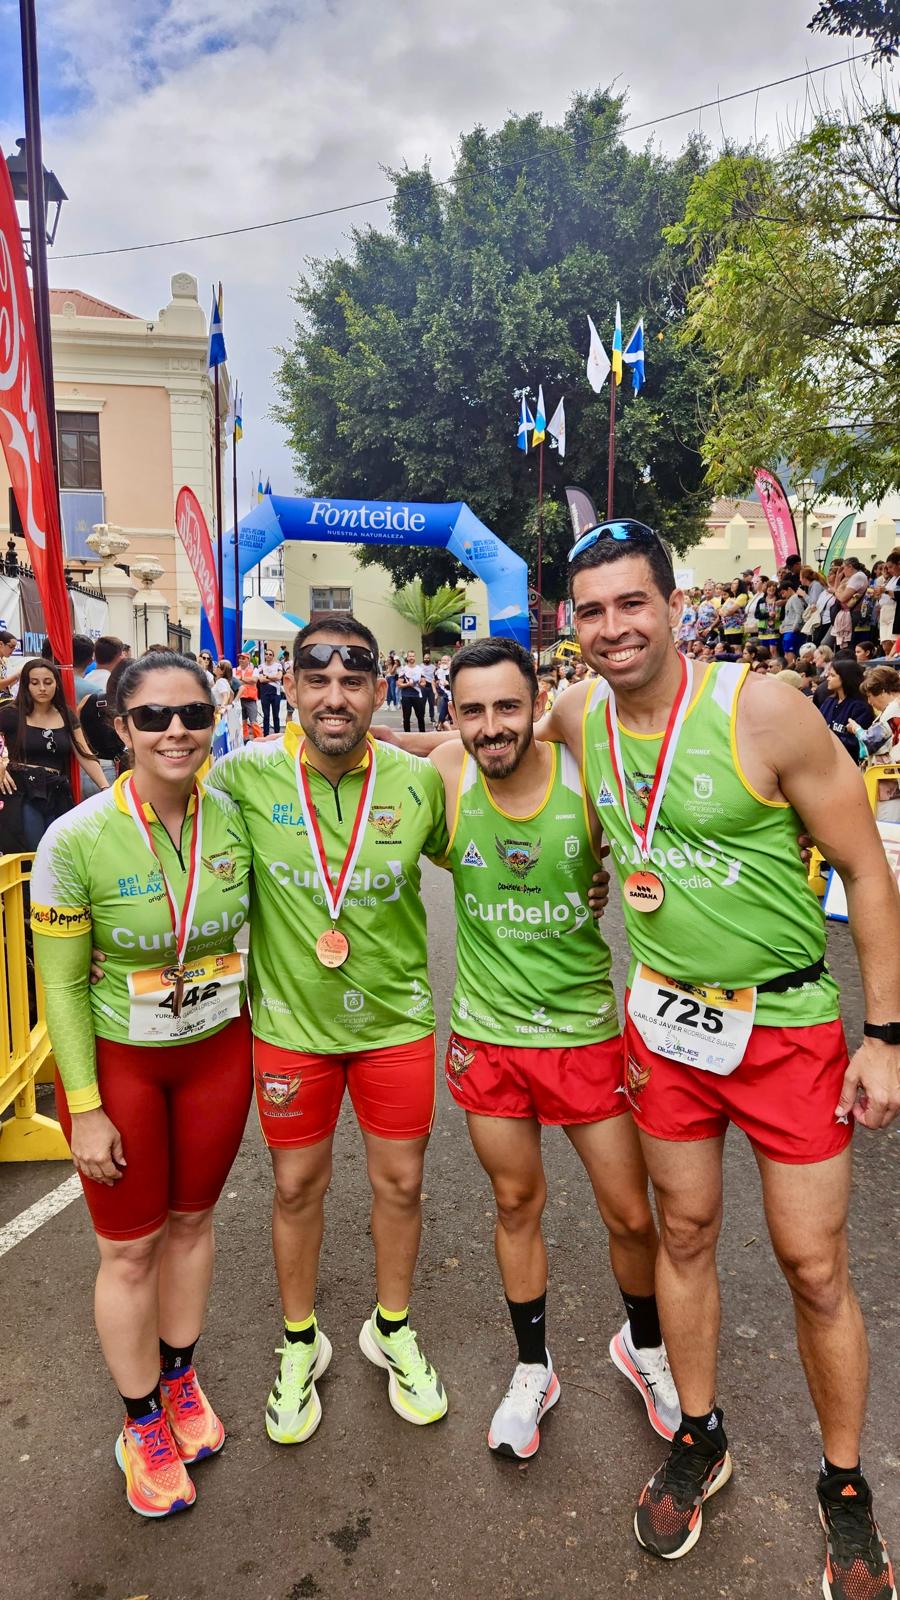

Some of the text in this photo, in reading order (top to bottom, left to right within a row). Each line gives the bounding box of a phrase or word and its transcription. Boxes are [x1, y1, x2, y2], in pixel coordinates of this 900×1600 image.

[306, 501, 426, 532] Fonteide
[327, 529, 358, 537] NUESTRA
[465, 618, 474, 629] P
[273, 803, 293, 813] gel
[272, 812, 306, 826] RËLA
[118, 875, 139, 888] gel
[120, 882, 162, 897] RËLAX
[629, 890, 658, 901] SANTANA
[464, 893, 570, 925] Curbelo
[497, 926, 560, 942] Ortopedia
[657, 989, 724, 1035] 725
[633, 1011, 658, 1024] CARLOS
[659, 1021, 683, 1033] JAVIER
[514, 1025, 575, 1034] TENERIFE
